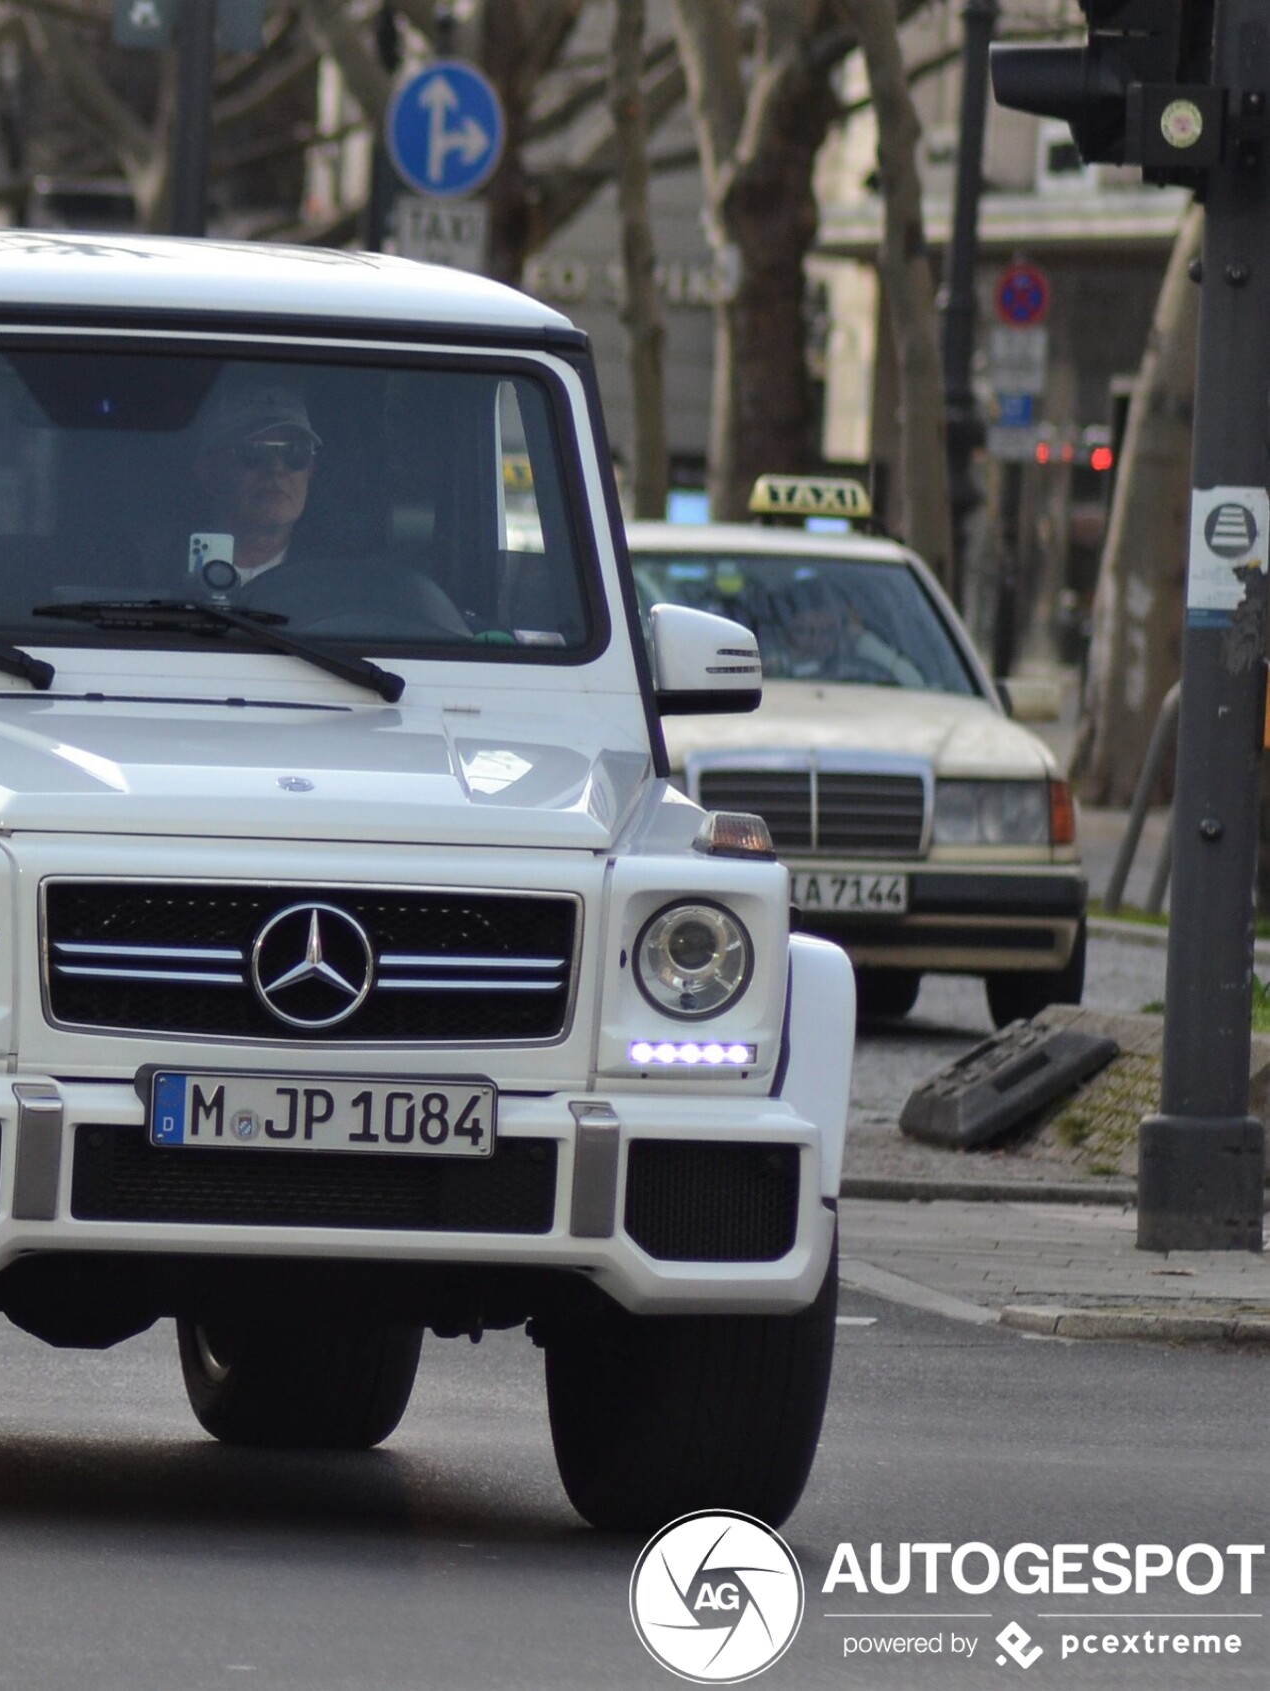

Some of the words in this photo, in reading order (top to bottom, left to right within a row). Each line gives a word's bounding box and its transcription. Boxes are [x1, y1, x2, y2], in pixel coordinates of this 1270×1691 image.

[767, 483, 857, 508] TAXI
[162, 1116, 174, 1132] D
[191, 1084, 225, 1136] M
[265, 1087, 334, 1140] JP
[348, 1090, 484, 1146] 1084
